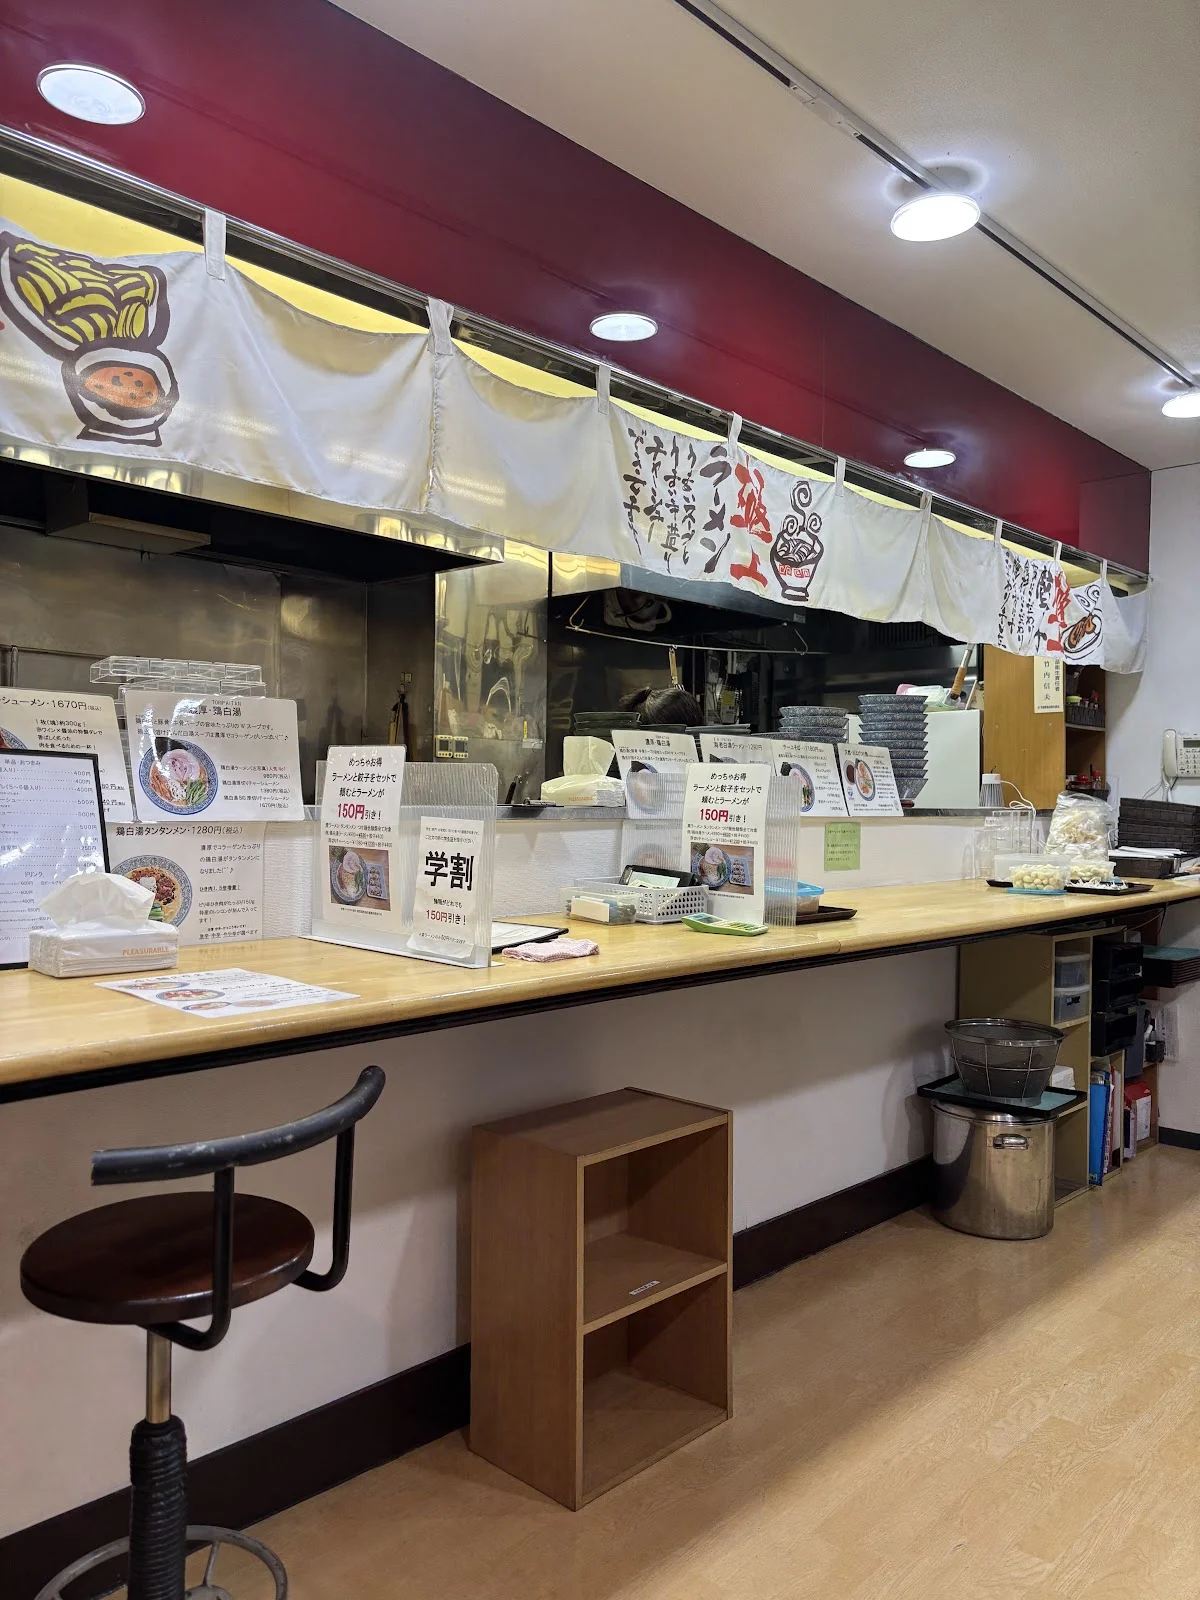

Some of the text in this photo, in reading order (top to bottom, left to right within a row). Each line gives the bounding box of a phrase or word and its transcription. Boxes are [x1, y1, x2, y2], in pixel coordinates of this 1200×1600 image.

[643, 435, 667, 543] チャーシュー
[700, 445, 732, 574] ラーメン
[4, 758, 41, 766] 単品・おつまみ
[348, 757, 383, 767] めっちゃお得
[332, 772, 397, 783] ラーメンと餃子をセットで
[710, 773, 747, 781] めっちゃお得
[339, 787, 385, 798] 頼むとラーメンが
[693, 784, 762, 794] ラーメンと餃子をセットで
[701, 795, 750, 805] 頼むとラーメンが
[200, 843, 261, 851] 濃厚でコラーゲンたっぷり
[200, 855, 260, 863] の鶏白湯がタンタンメンに
[424, 850, 475, 891] 学割
[122, 945, 169, 955] PLEASURABLE
